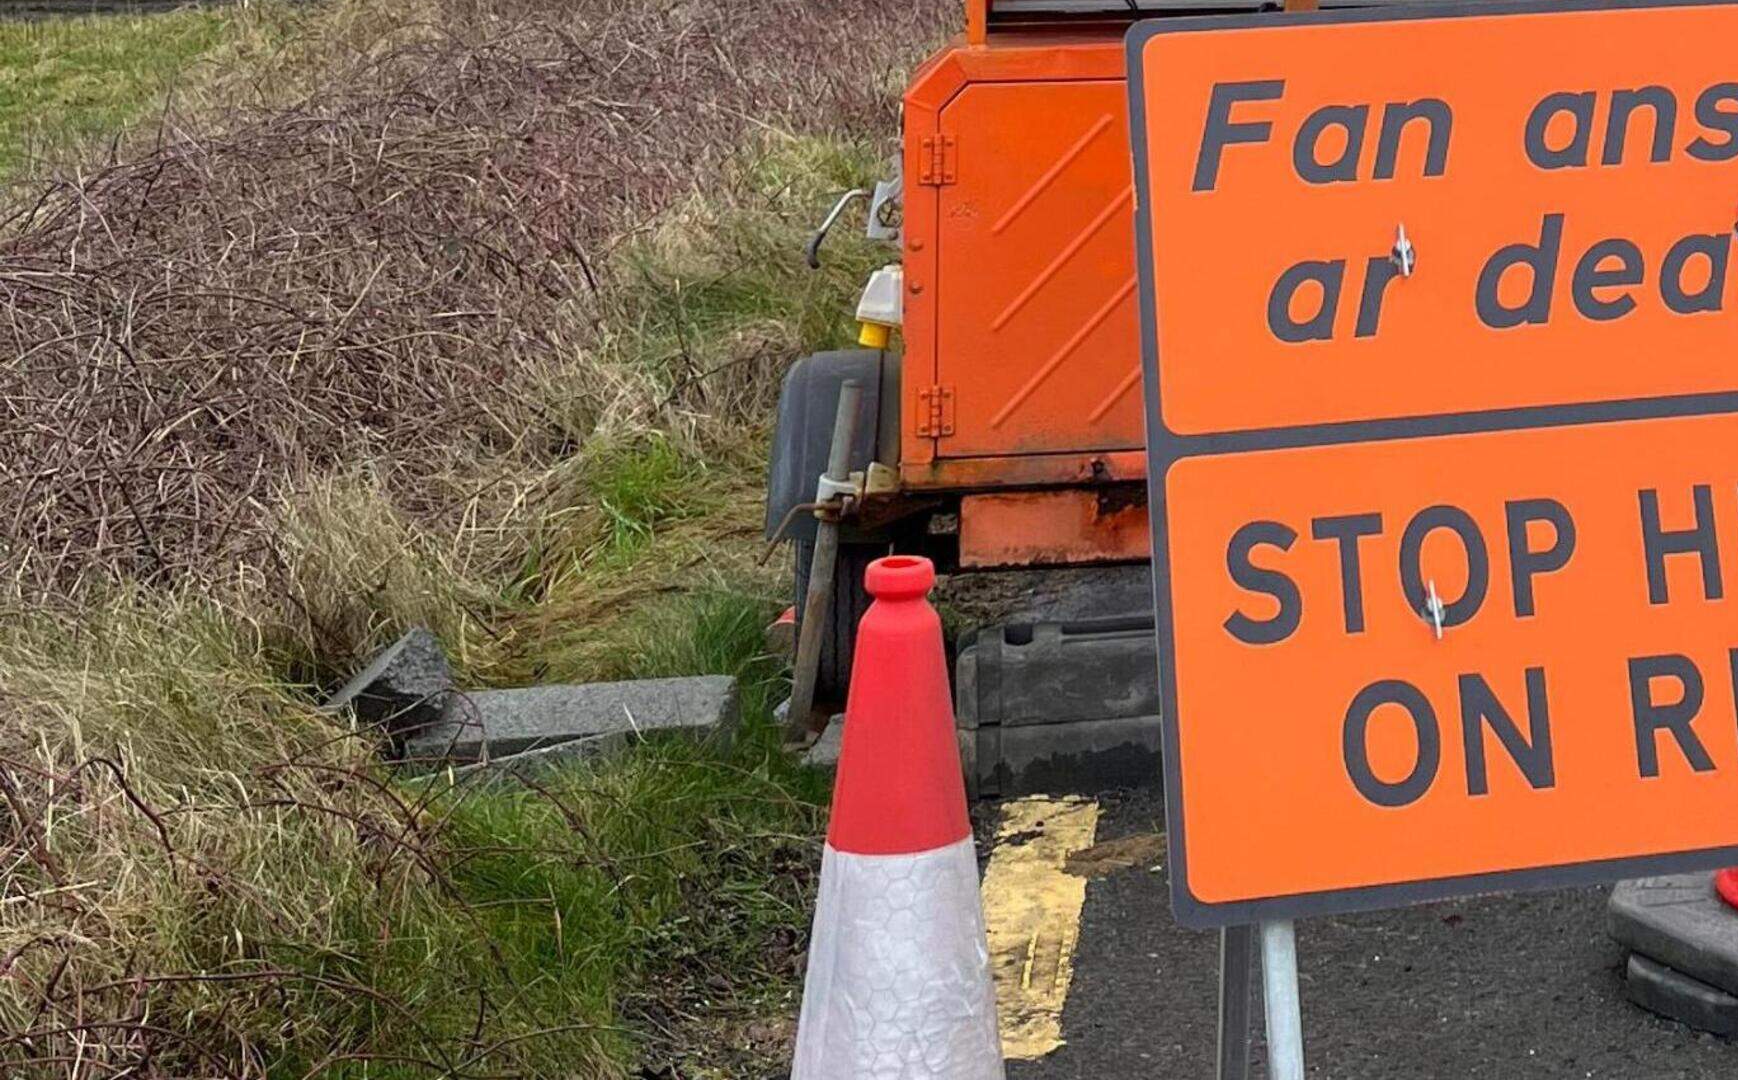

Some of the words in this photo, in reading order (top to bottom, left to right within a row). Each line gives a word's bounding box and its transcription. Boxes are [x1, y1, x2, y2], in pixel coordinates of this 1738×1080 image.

[1194, 80, 1452, 191] Fan
[1268, 248, 1405, 342] ar
[1224, 497, 1577, 645] STOP
[1344, 667, 1554, 807] ON
